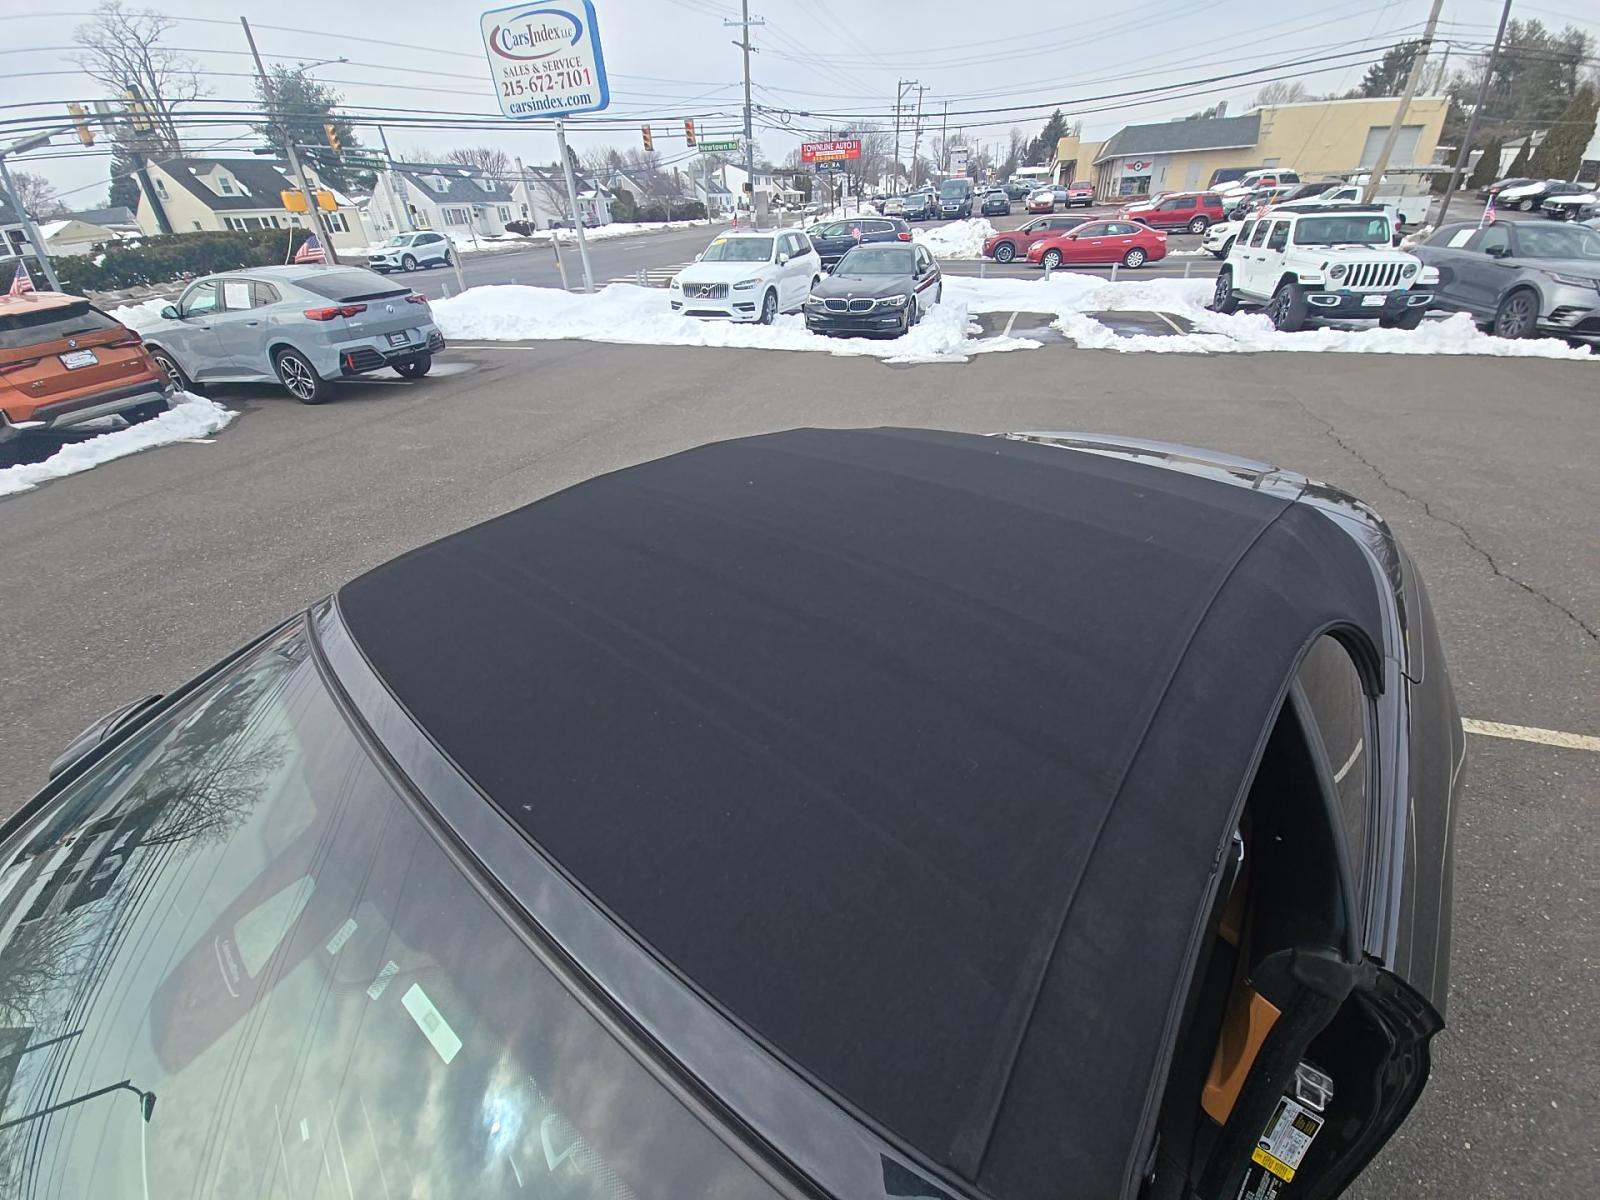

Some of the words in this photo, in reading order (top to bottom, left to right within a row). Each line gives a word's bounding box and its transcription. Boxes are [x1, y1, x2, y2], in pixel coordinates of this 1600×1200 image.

[502, 23, 561, 51] CarsIndex
[560, 28, 573, 39] LLC
[503, 63, 530, 78] SALES
[532, 64, 540, 74] &
[542, 56, 582, 72] SERVICE
[502, 67, 592, 97] 215-672-7101
[510, 92, 592, 114] carsindex.com
[803, 143, 834, 152] TOWNLINE
[836, 141, 852, 150] AUTO
